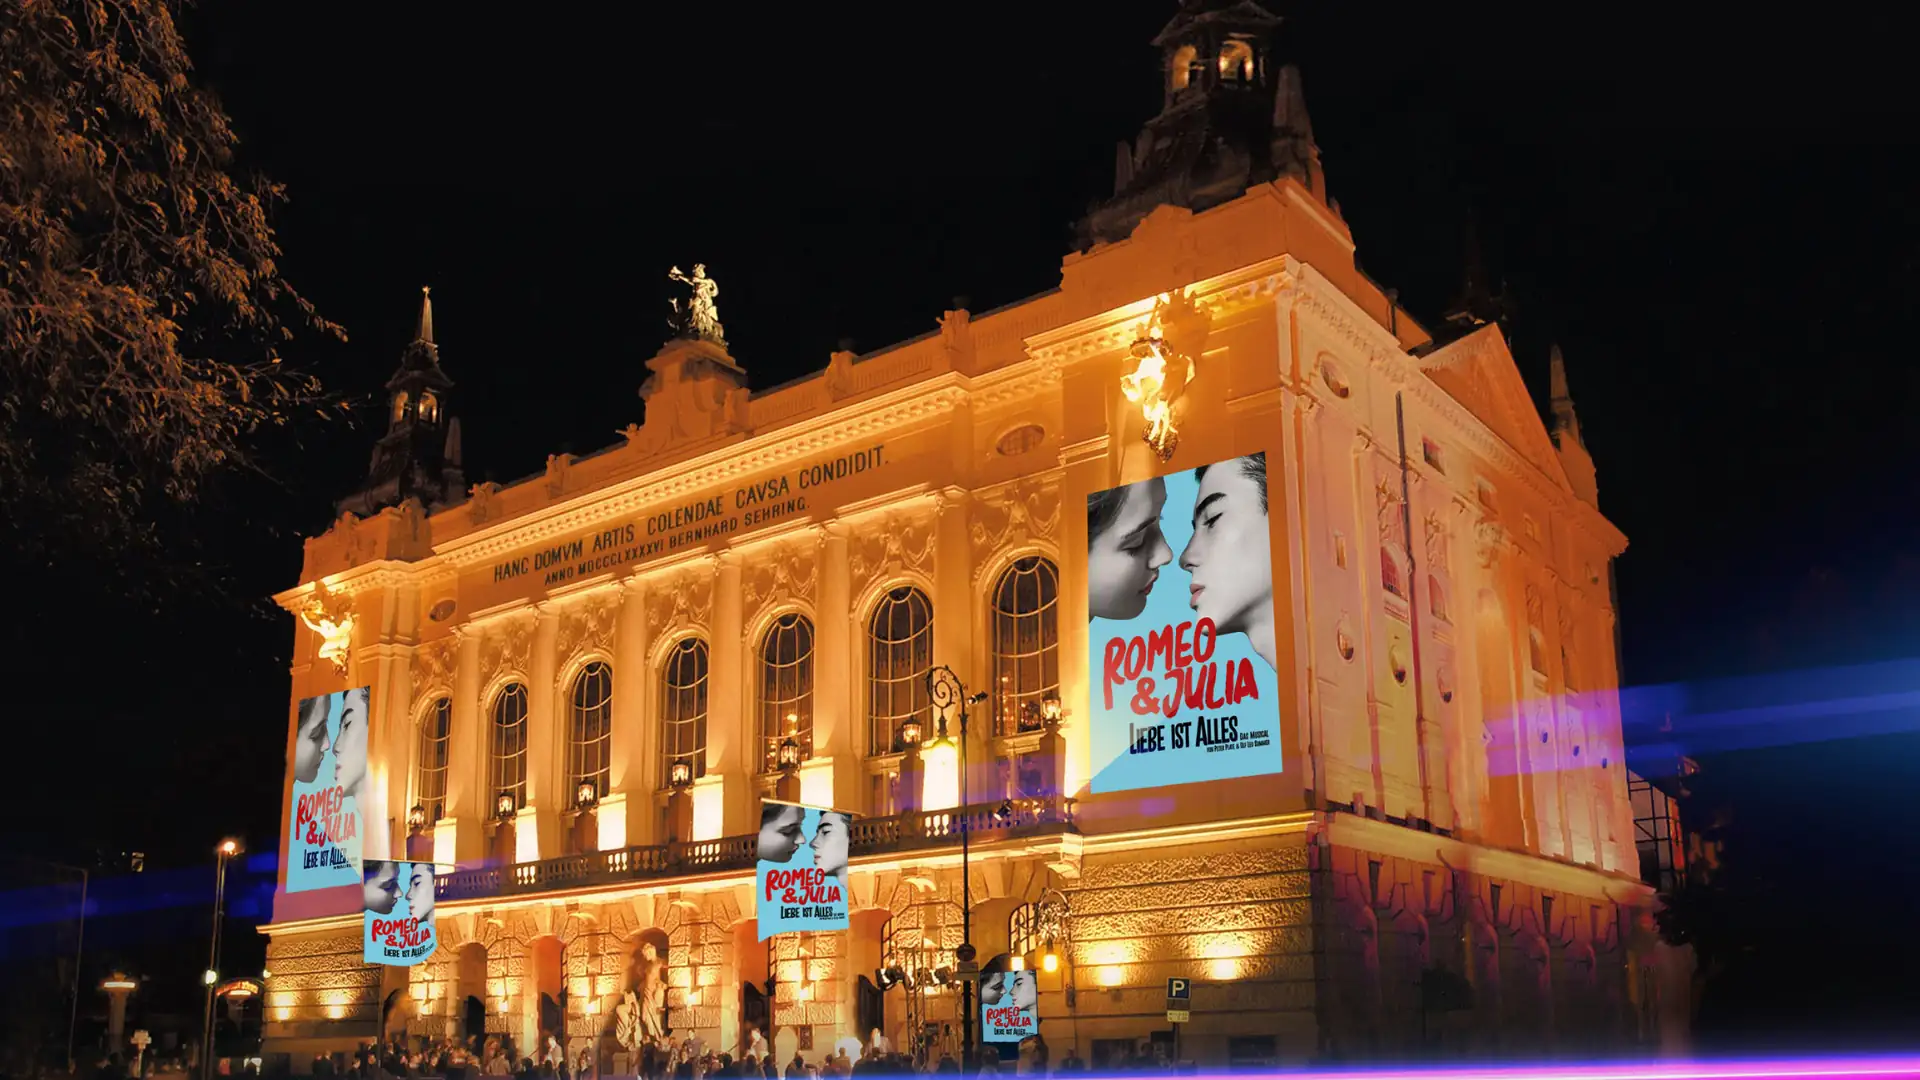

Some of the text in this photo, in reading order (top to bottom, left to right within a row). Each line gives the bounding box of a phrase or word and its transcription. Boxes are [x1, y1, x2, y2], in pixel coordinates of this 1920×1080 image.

[494, 445, 889, 582] HANC DOMVM ARTIS COLENDAE CAVSA CONDIDIT.
[545, 566, 574, 587] ANNO
[669, 517, 737, 550] BERNHARD
[1102, 616, 1217, 711] ROMEO
[1162, 657, 1259, 719] JULIA
[295, 784, 344, 841] ROMEO
[318, 812, 356, 848] JULIA
[765, 867, 825, 902] ROMEO
[798, 885, 841, 906] JULIA
[371, 917, 418, 943] ROMEO
[398, 927, 431, 949] JULIA
[1172, 980, 1185, 997] P
[986, 1006, 1020, 1024] ROMEO
